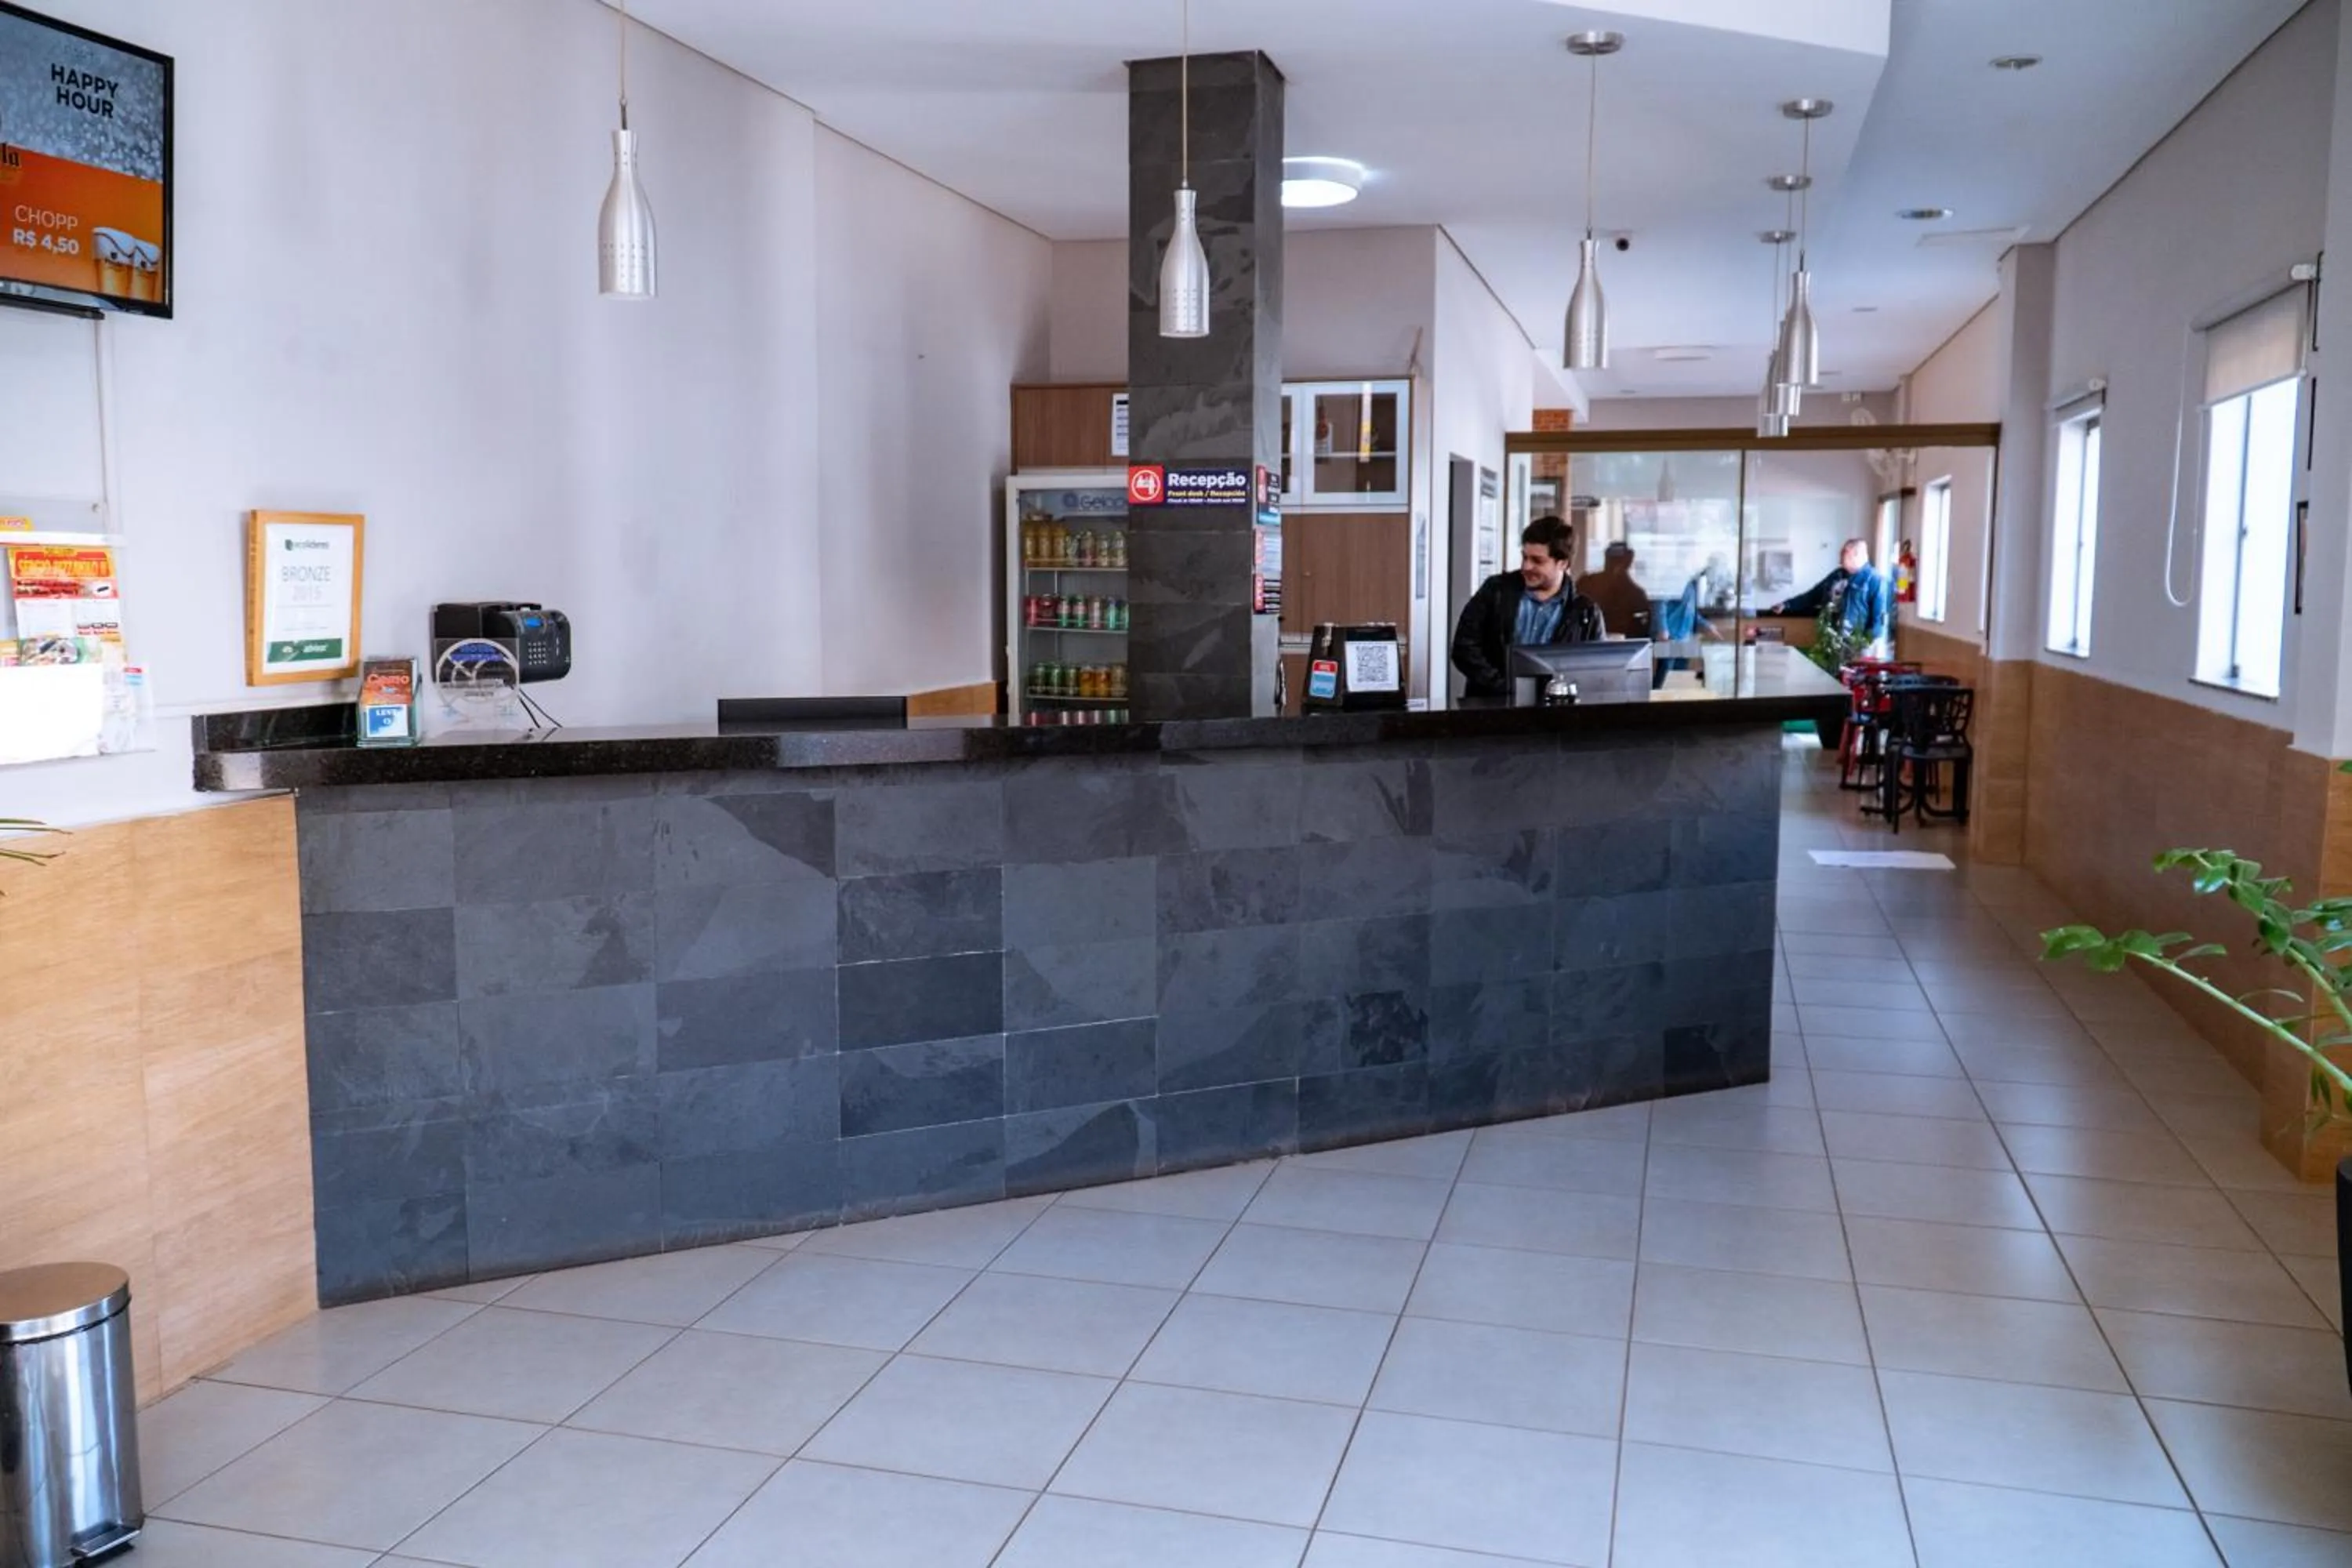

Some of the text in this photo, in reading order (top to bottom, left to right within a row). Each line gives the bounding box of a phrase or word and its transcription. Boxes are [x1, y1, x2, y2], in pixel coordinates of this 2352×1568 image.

[51, 63, 119, 99] HAPPY
[56, 85, 114, 118] HOUR
[14, 205, 78, 230] CHOPP
[13, 228, 80, 255] R$ 4,50
[1167, 472, 1247, 488] Recepção
[281, 566, 332, 582] BRONZE
